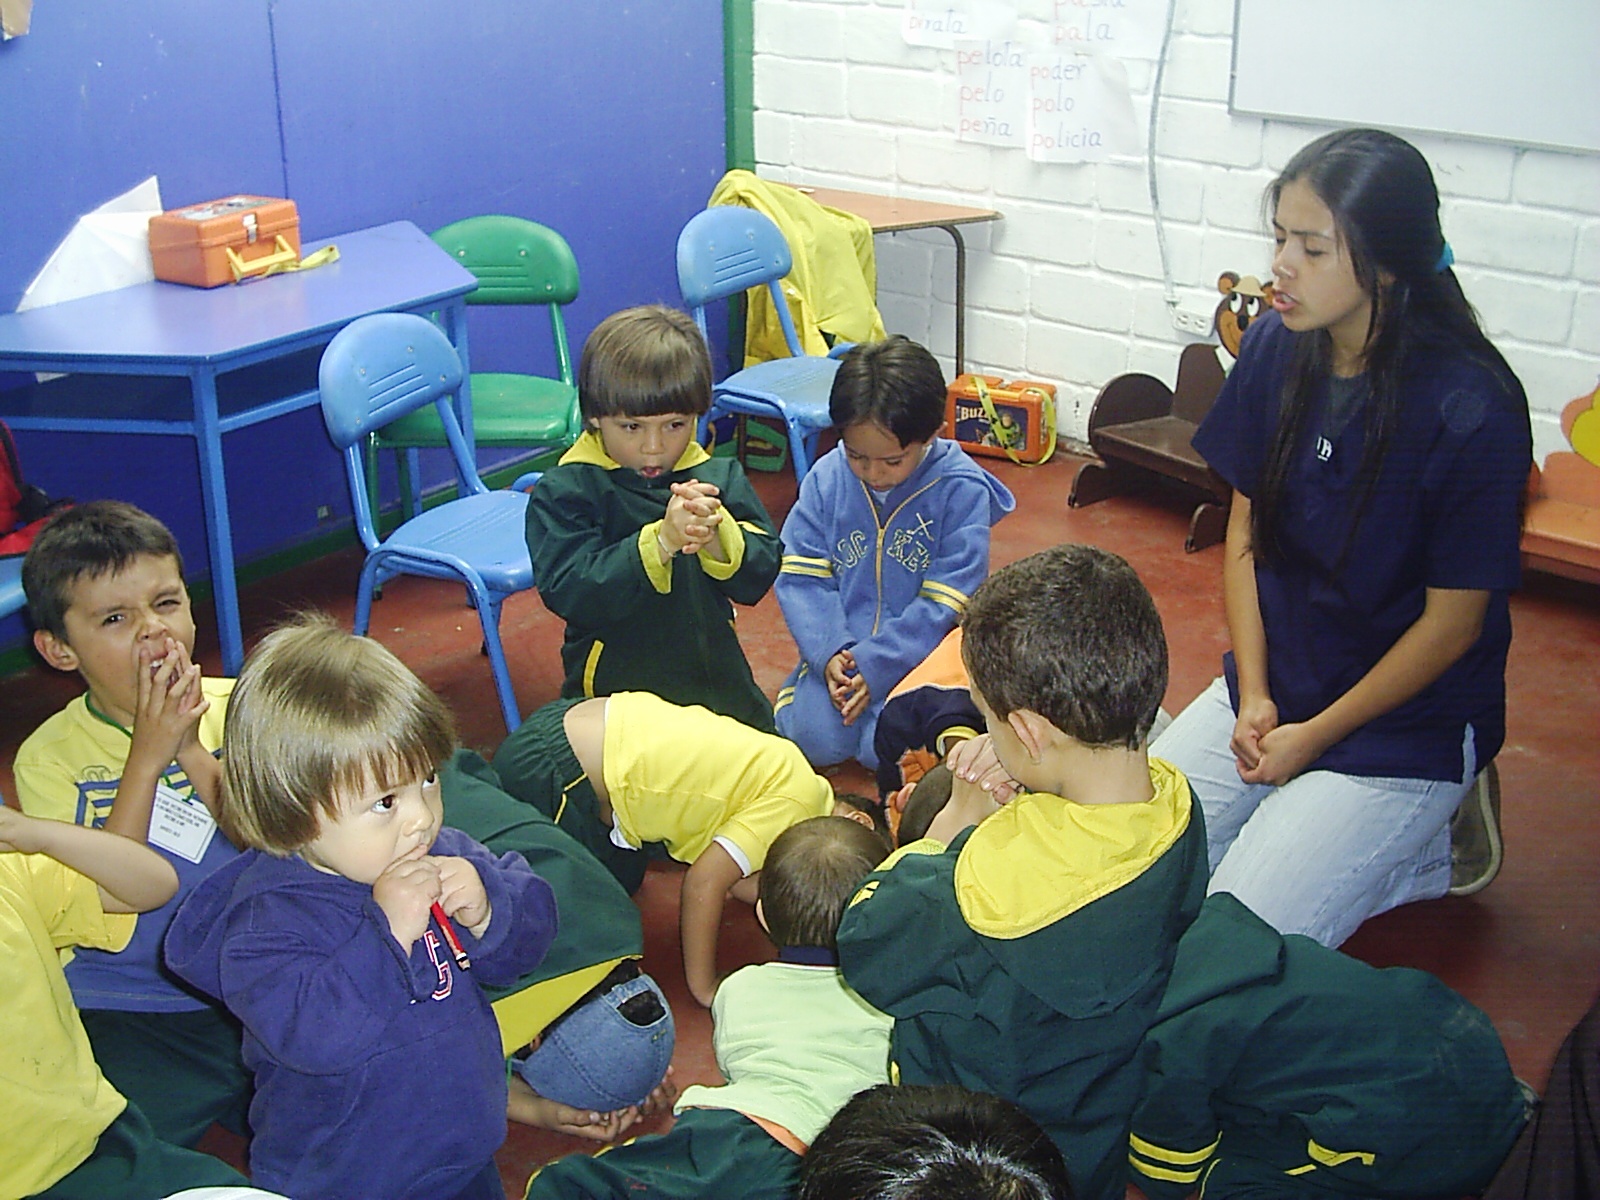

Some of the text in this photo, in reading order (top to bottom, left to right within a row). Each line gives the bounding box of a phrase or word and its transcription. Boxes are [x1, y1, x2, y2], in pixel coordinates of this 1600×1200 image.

[1054, 10, 1115, 45] pala
[957, 39, 1024, 75] pelota
[1030, 57, 1087, 90] poder
[959, 72, 1004, 115] pelo
[1032, 83, 1075, 127] polo
[959, 117, 1012, 141] peña
